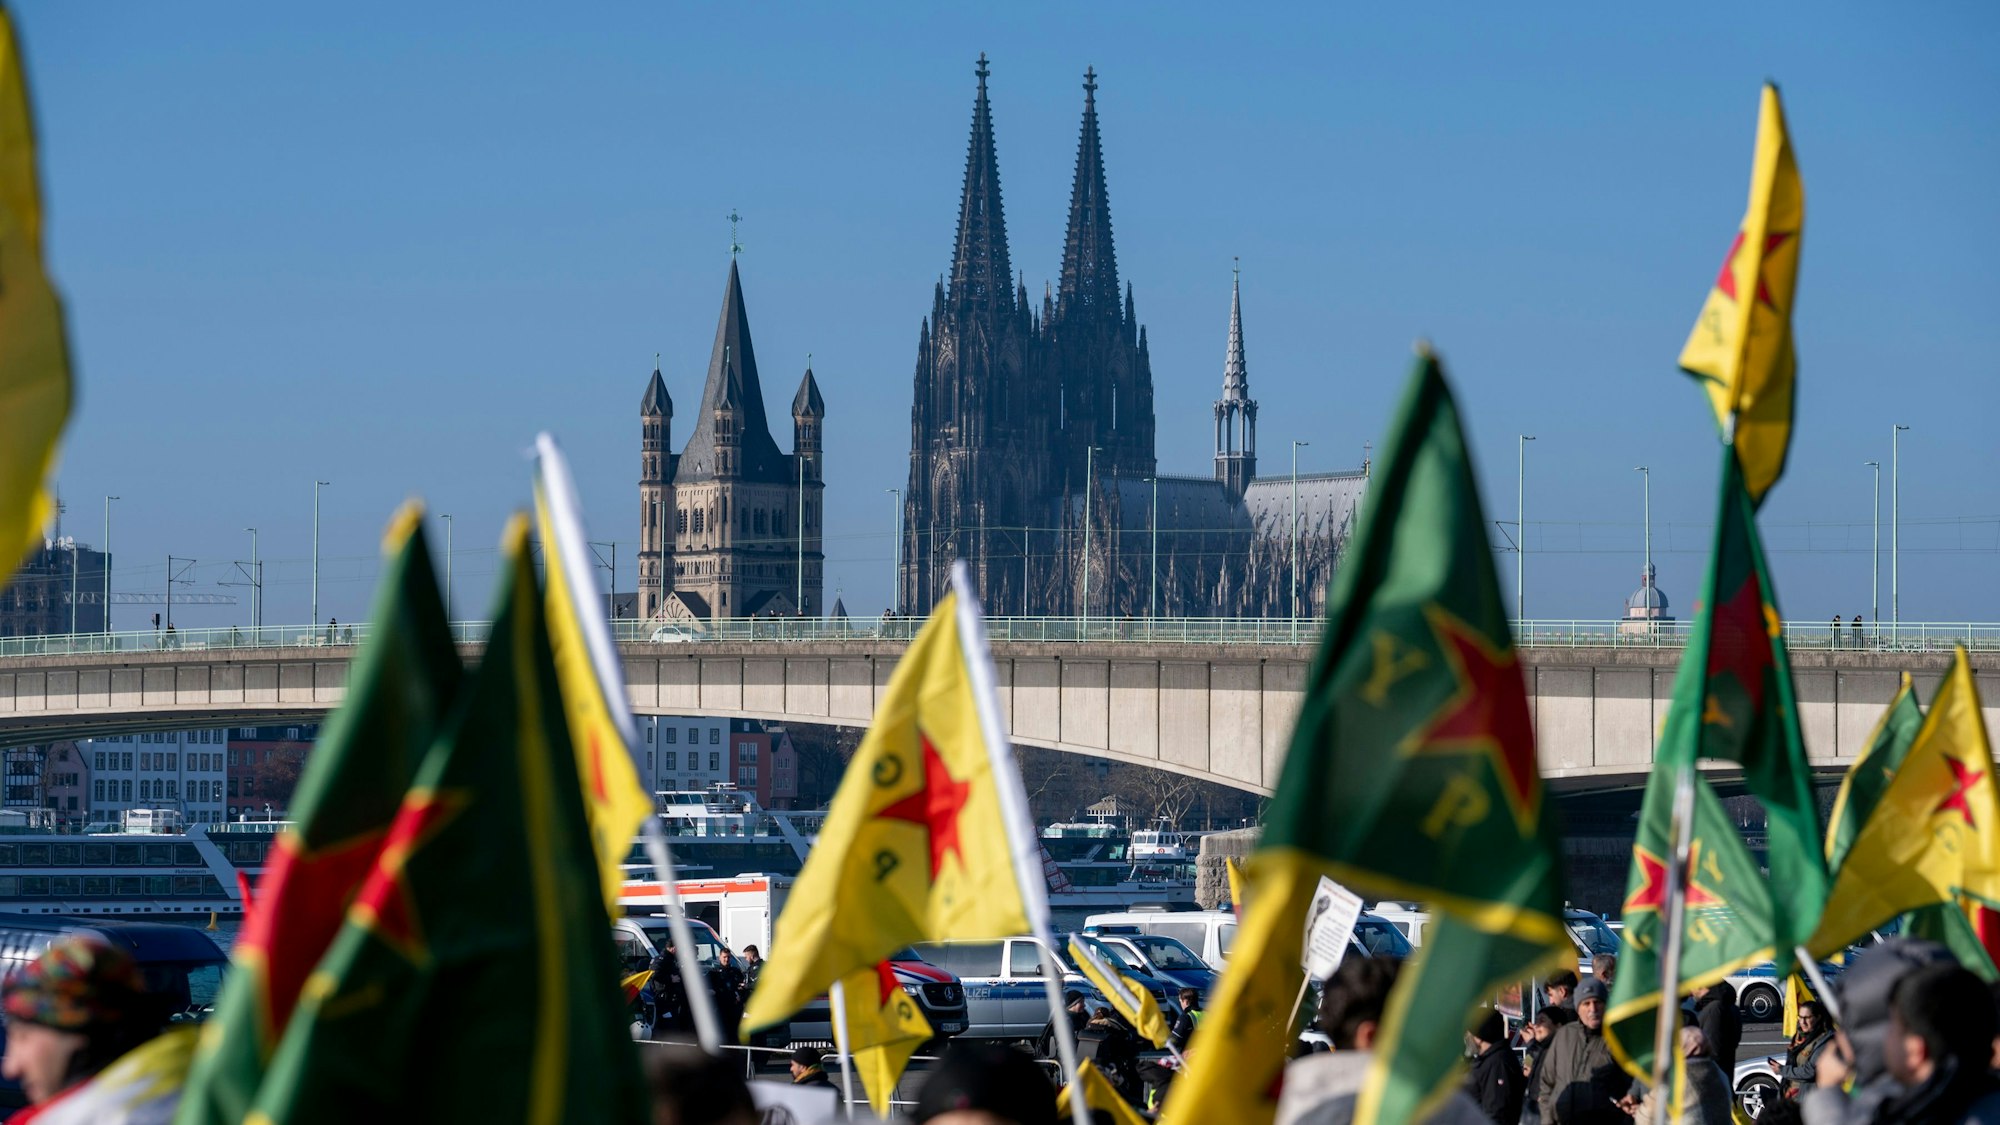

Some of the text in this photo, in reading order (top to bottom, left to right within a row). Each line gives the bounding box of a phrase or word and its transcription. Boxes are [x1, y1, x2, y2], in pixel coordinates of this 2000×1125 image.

[1362, 632, 1427, 705] Y
[1421, 773, 1491, 840] P
[965, 988, 991, 997] LIZEI
